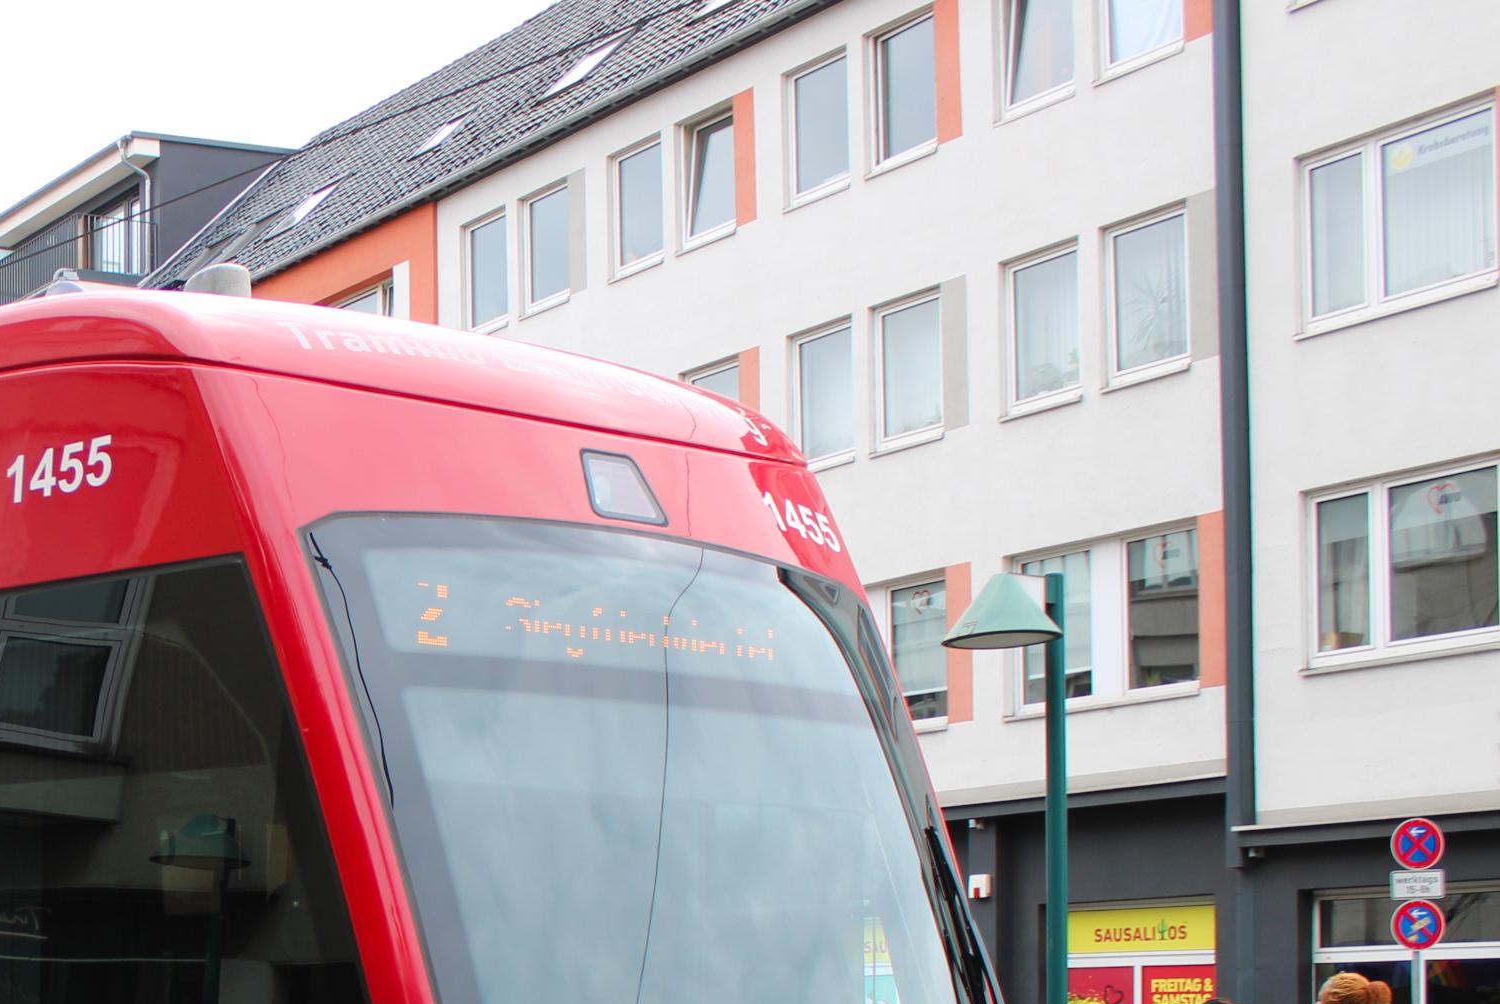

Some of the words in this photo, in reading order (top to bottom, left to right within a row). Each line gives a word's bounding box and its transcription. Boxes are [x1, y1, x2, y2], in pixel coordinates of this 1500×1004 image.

[6, 434, 112, 504] 1455
[763, 491, 841, 553] 1455
[417, 582, 450, 648] 2
[1151, 977, 1202, 993] FREITAG
[1203, 977, 1214, 992] &
